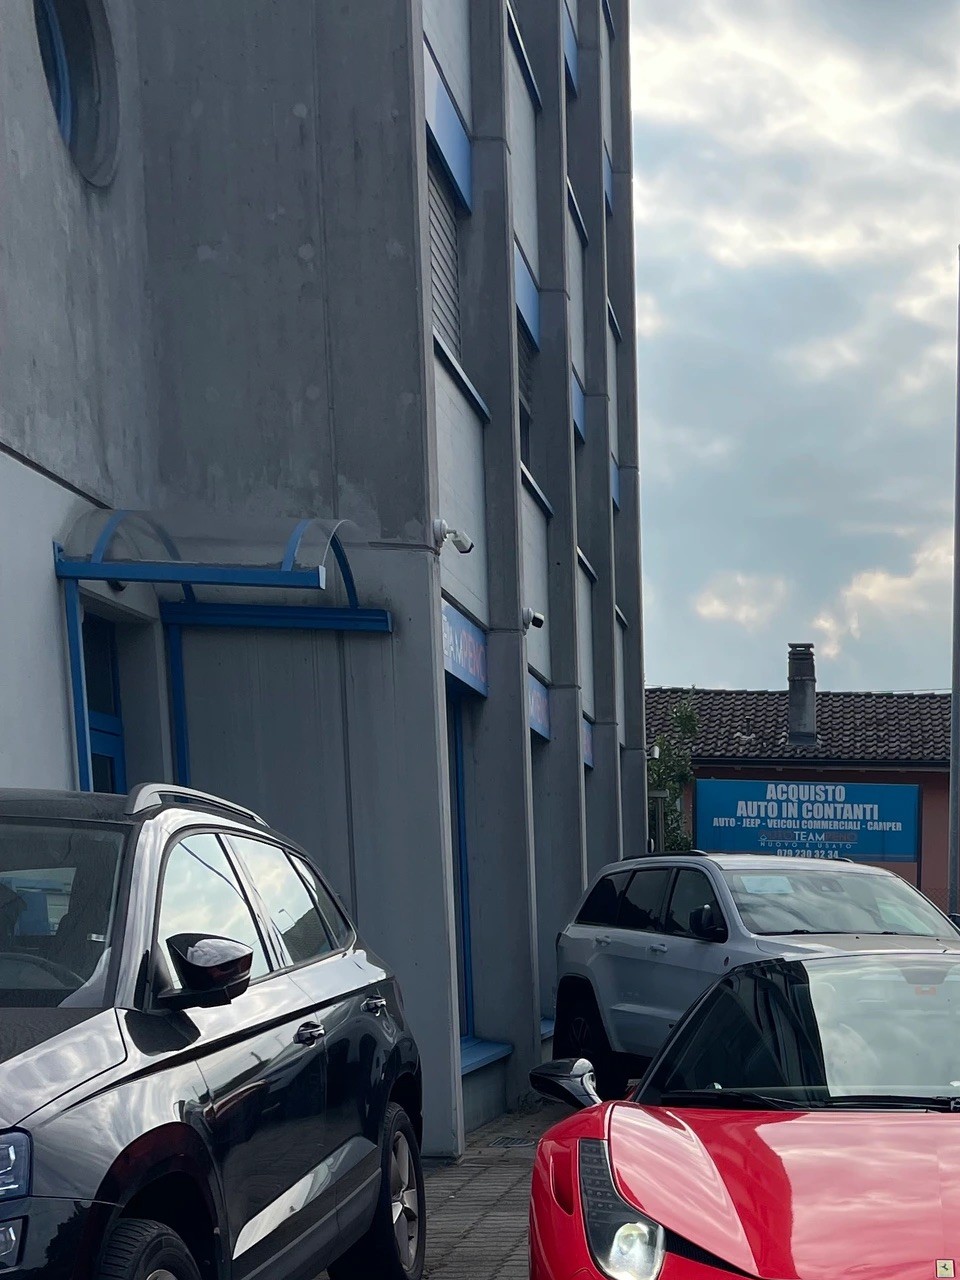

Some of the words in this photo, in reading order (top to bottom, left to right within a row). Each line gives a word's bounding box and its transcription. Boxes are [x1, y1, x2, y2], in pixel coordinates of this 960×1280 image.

[766, 783, 846, 802] ACQUISTO
[736, 800, 779, 818] AUTO
[781, 801, 798, 818] IN
[801, 802, 879, 820] CONTANTI
[713, 817, 736, 828] AUTO
[742, 818, 761, 829] JEEP
[767, 819, 800, 830] VEICOLI
[801, 820, 860, 831] COMMERCIALI
[867, 821, 902, 832] CAMPER
[777, 848, 793, 857] 079
[794, 849, 812, 858] 230
[814, 850, 825, 859] 32
[827, 850, 839, 859] 34
